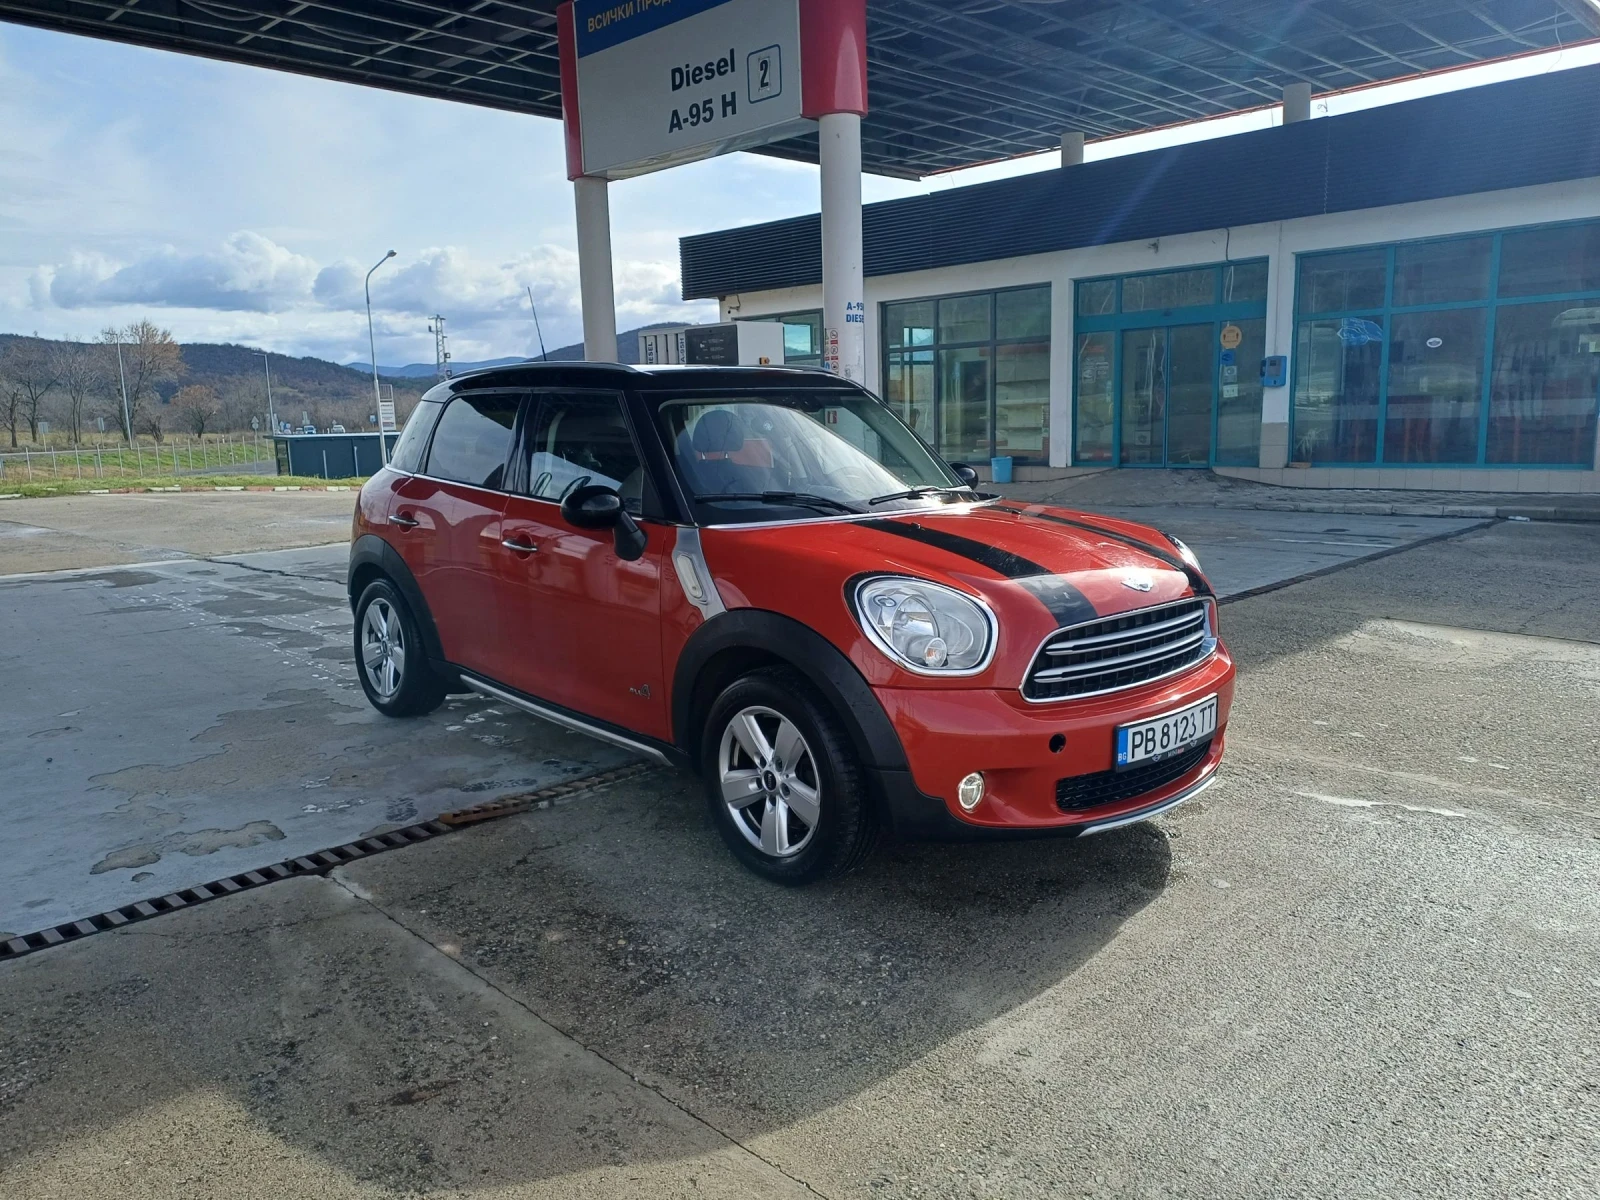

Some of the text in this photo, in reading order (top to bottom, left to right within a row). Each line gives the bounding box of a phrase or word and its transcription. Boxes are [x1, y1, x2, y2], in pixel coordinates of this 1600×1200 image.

[587, 1, 634, 33] ВСИЧКИ
[670, 48, 736, 91] Diesel
[758, 59, 769, 88] 2
[668, 91, 737, 133] A-95 H
[845, 313, 864, 323] DIES
[1131, 702, 1215, 759] PB 8123 TT
[1117, 751, 1127, 763] BG
